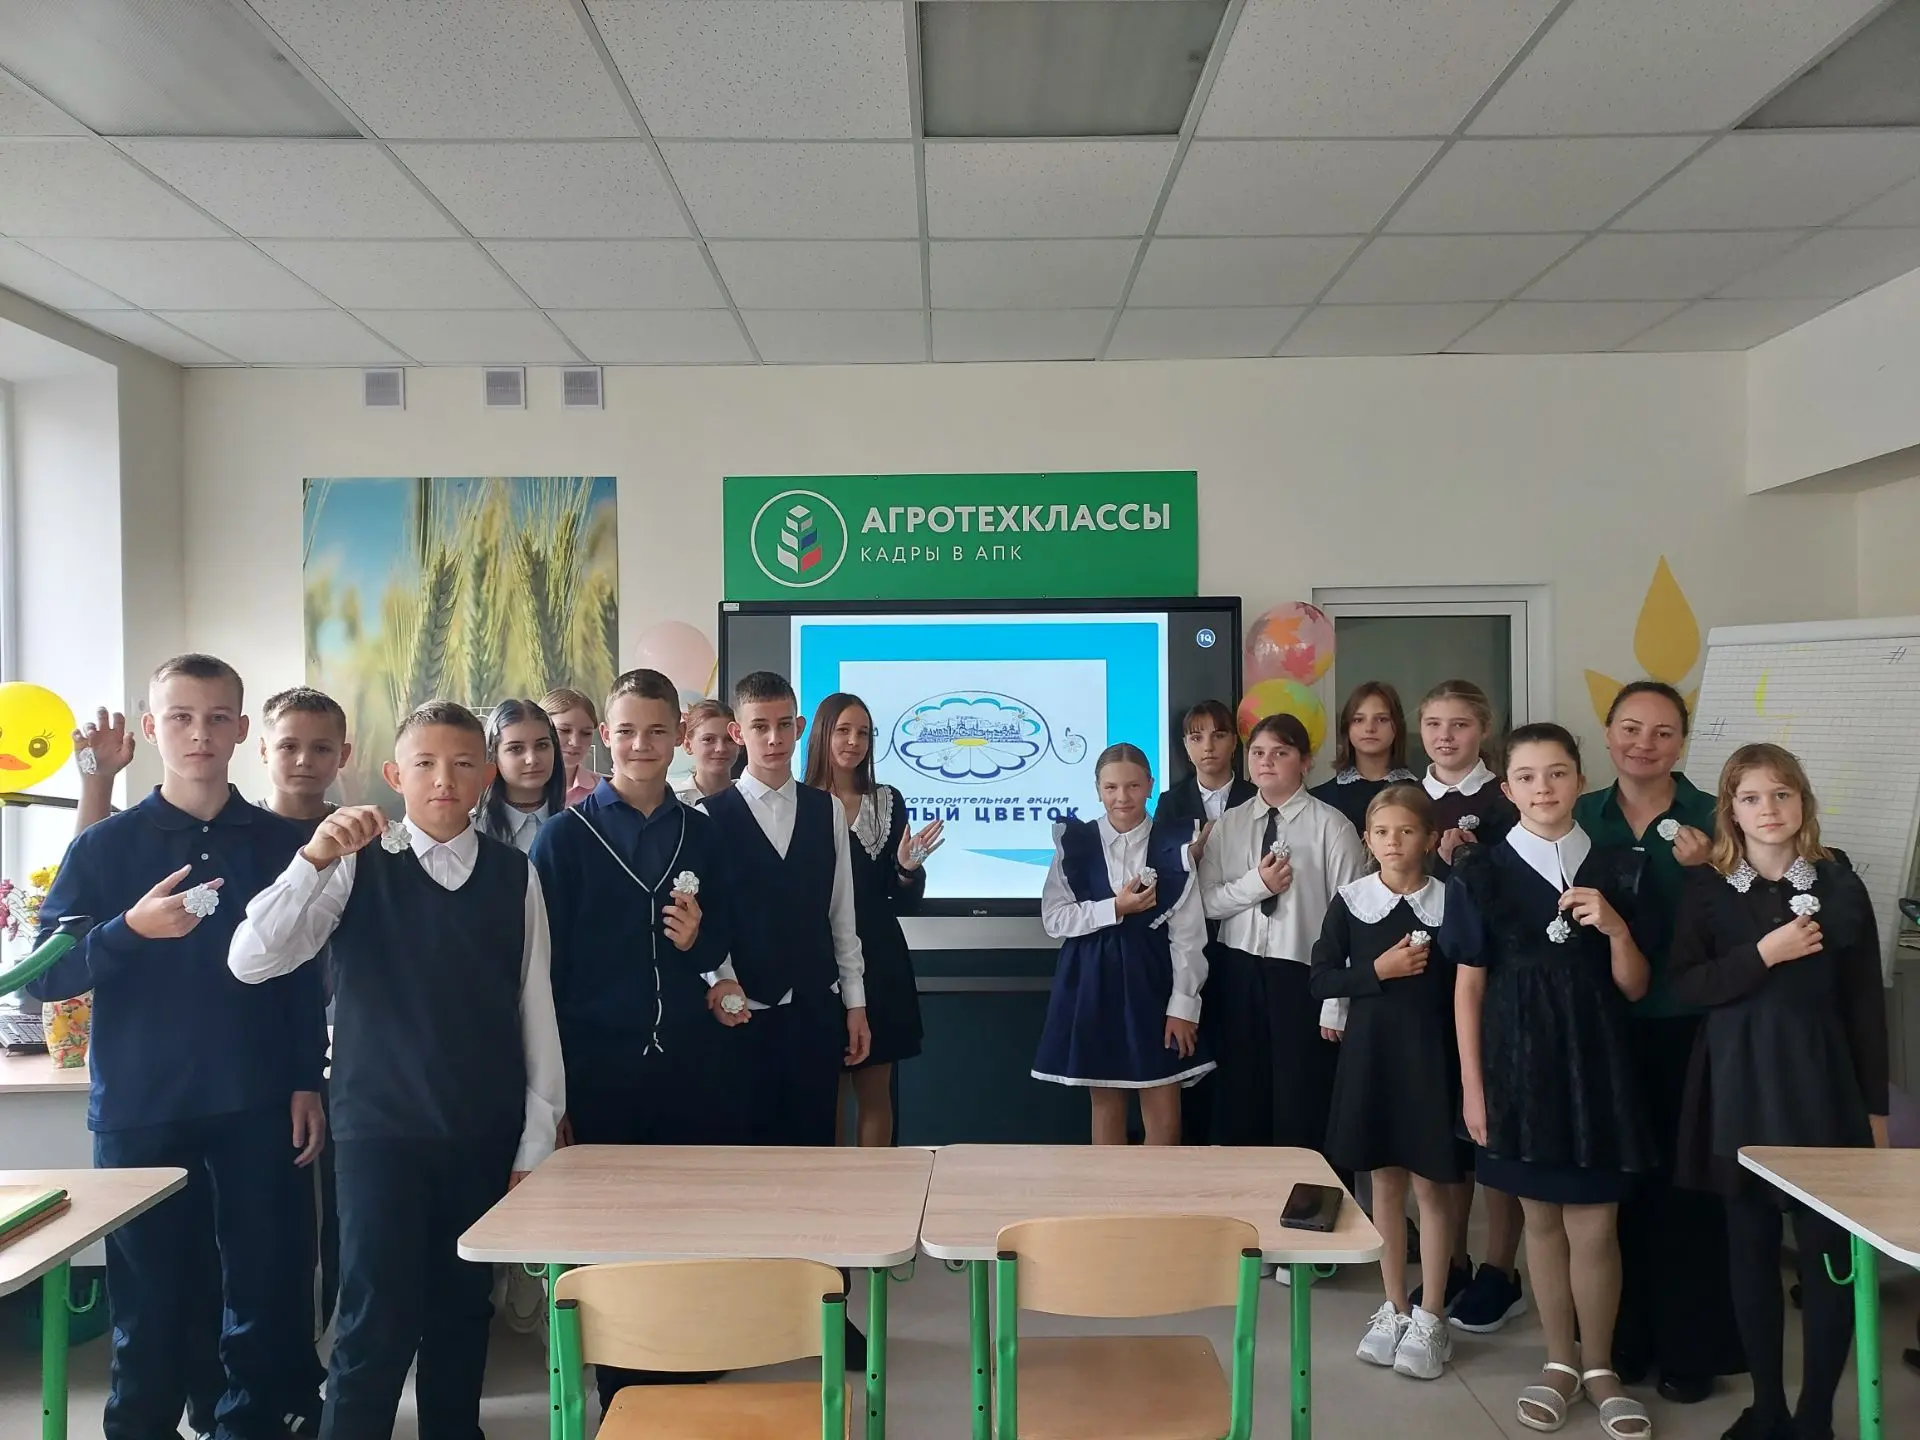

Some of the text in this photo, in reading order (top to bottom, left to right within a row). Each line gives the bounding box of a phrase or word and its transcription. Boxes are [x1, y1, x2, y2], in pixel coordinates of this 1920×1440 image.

[861, 503, 1170, 533] АГРОТЕХКЛАССЫ
[861, 545, 1022, 564] КАДРЫ В АПК
[904, 797, 1069, 806] готворительная акция
[905, 804, 1080, 823] ЛЫЙ ЦВЕТОК
